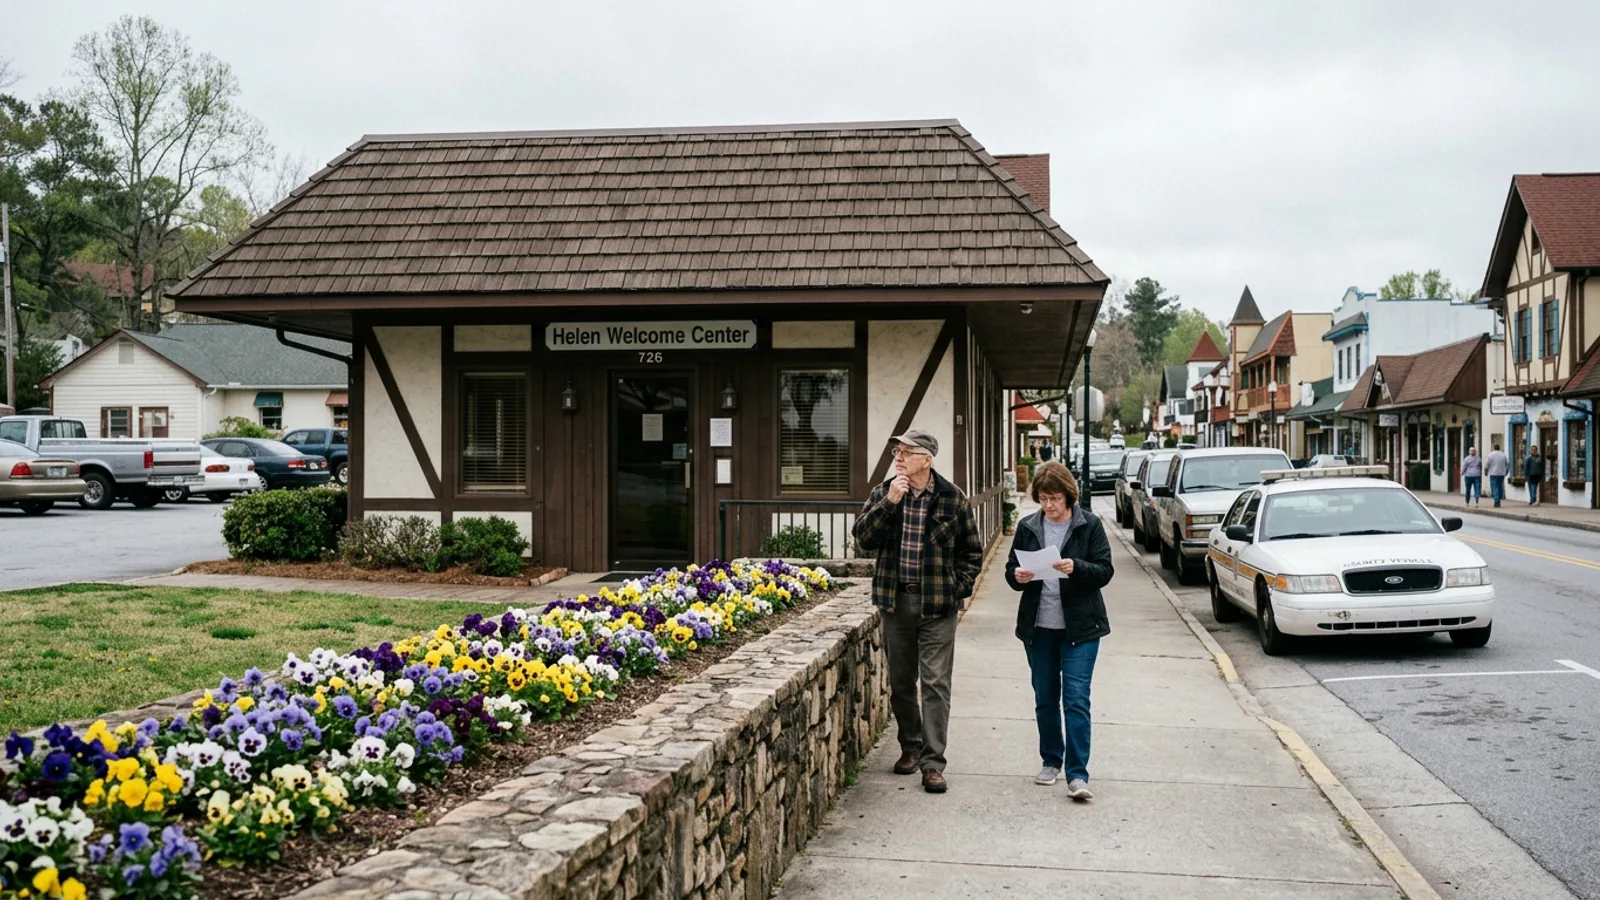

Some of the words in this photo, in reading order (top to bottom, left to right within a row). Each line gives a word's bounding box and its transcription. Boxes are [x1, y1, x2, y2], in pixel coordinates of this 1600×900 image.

[553, 327, 601, 345] Helen
[607, 326, 686, 344] Welcome
[692, 325, 749, 344] Center
[638, 352, 663, 363] 726
